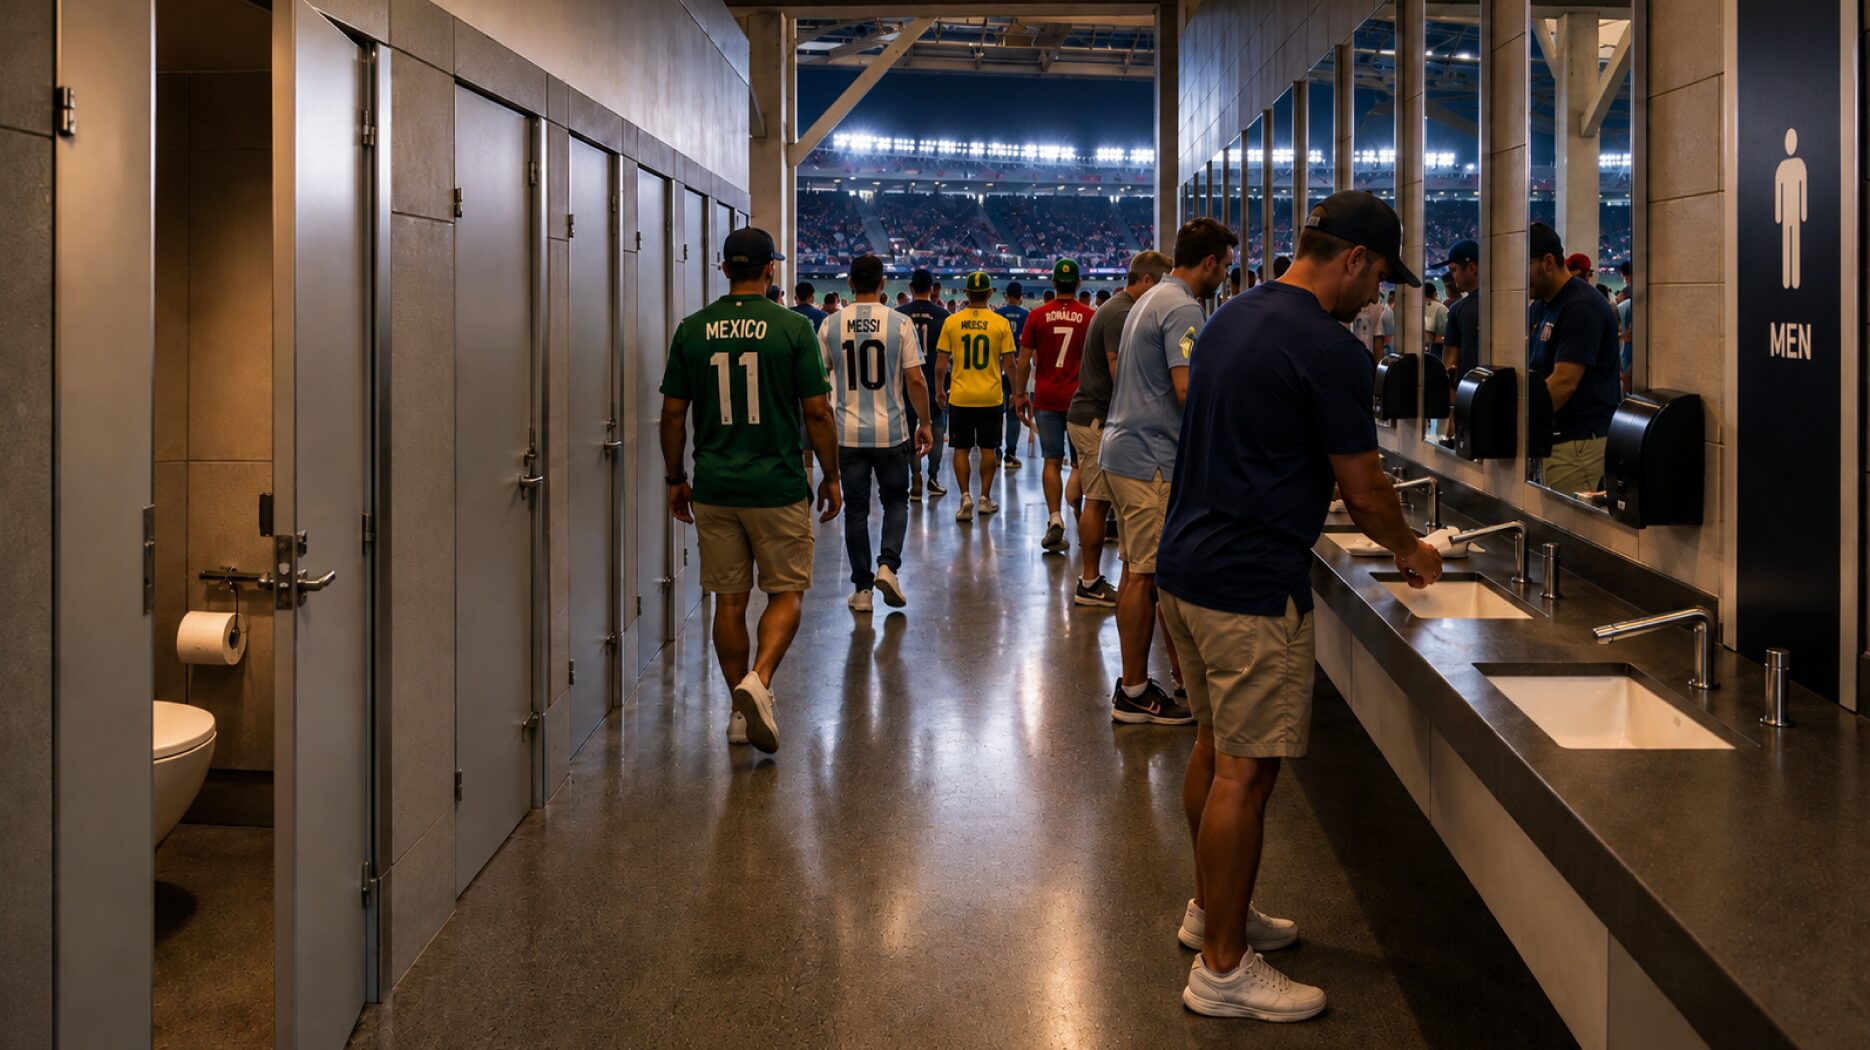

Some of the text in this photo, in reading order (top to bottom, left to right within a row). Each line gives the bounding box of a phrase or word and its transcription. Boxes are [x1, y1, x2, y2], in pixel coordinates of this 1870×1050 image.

[705, 318, 768, 341] MEXICO
[847, 318, 881, 334] MESSI
[1045, 310, 1083, 324] RONALDO
[961, 333, 990, 371] 10
[1053, 326, 1074, 368] 7
[1770, 321, 1812, 360] MEN
[842, 338, 887, 392] 10
[709, 351, 761, 426] 11
